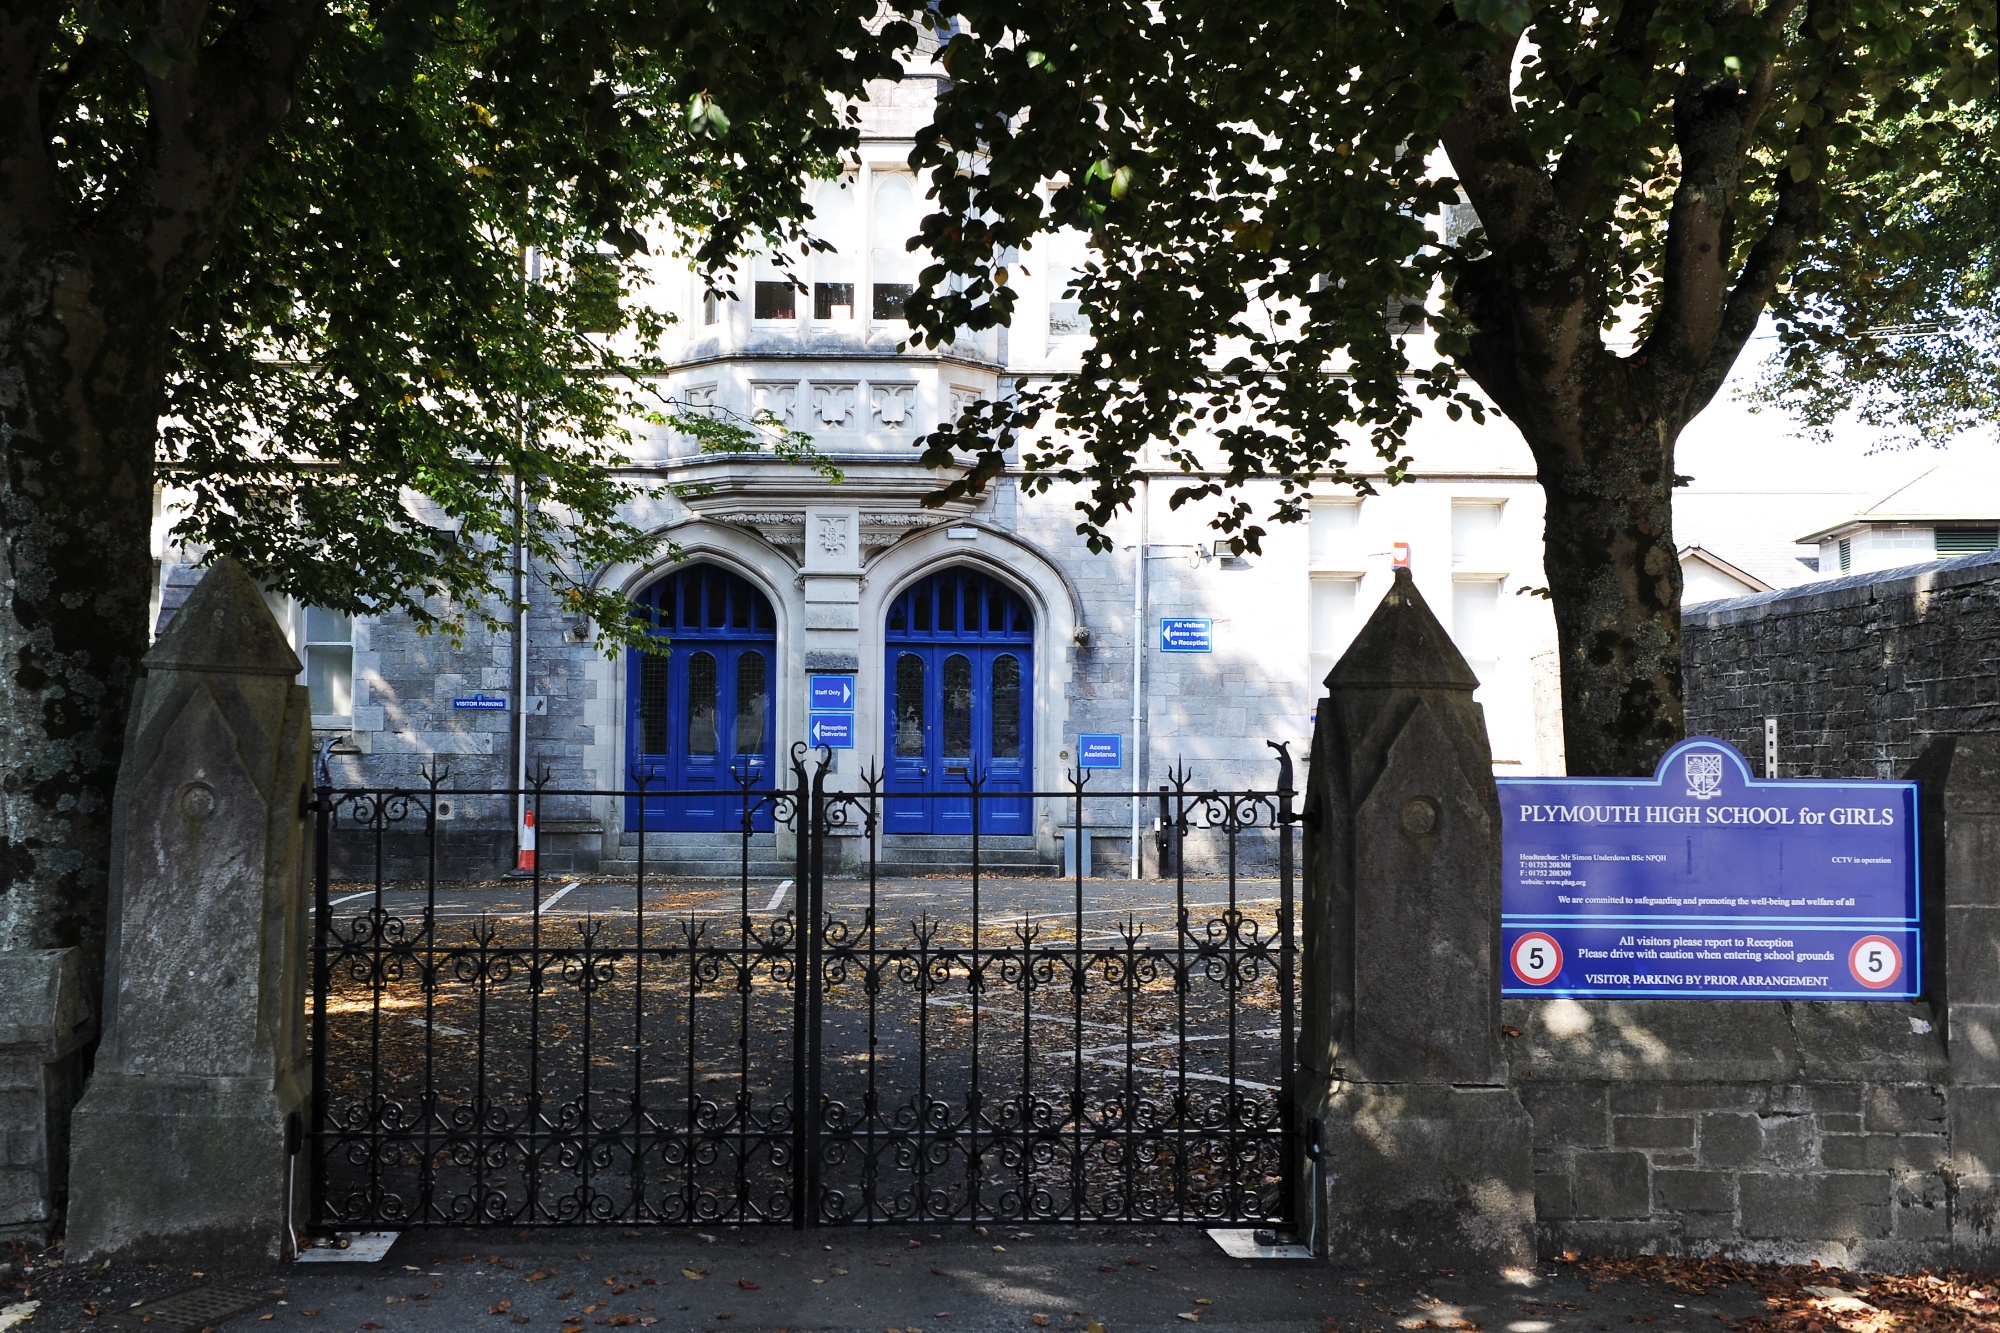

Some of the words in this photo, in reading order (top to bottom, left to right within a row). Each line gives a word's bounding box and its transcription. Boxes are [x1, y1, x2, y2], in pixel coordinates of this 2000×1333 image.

[1520, 805, 1640, 823] PLYMOUTH
[1645, 806, 1701, 823] HIGH
[1706, 806, 1794, 825] SCHOOL
[1799, 808, 1825, 825] for
[1830, 808, 1894, 825] GIRLS
[1634, 897, 1682, 906] safeguarding
[1698, 897, 1736, 906] promoting
[1751, 898, 1790, 907] well-being
[1619, 936, 1634, 946] All
[1636, 937, 1671, 946] visitors
[1673, 937, 1702, 948] please
[1704, 938, 1732, 948] report
[1734, 939, 1744, 947] to
[1746, 938, 1794, 949] Reception
[1530, 948, 1543, 969] 5
[1578, 949, 1608, 958] Please
[1610, 949, 1634, 958] drive
[1635, 950, 1658, 958] with
[1660, 950, 1694, 959] caution
[1696, 951, 1722, 960] when
[1724, 951, 1762, 962] entering
[1764, 951, 1794, 960] school
[1797, 952, 1834, 962] grounds
[1868, 951, 1882, 972] 5
[1585, 974, 1630, 984] VISITOR
[1633, 975, 1683, 985] PARKING
[1686, 975, 1701, 985] BY
[1704, 976, 1738, 985] PRIOR
[1740, 976, 1828, 986] ARRANGEMENT
